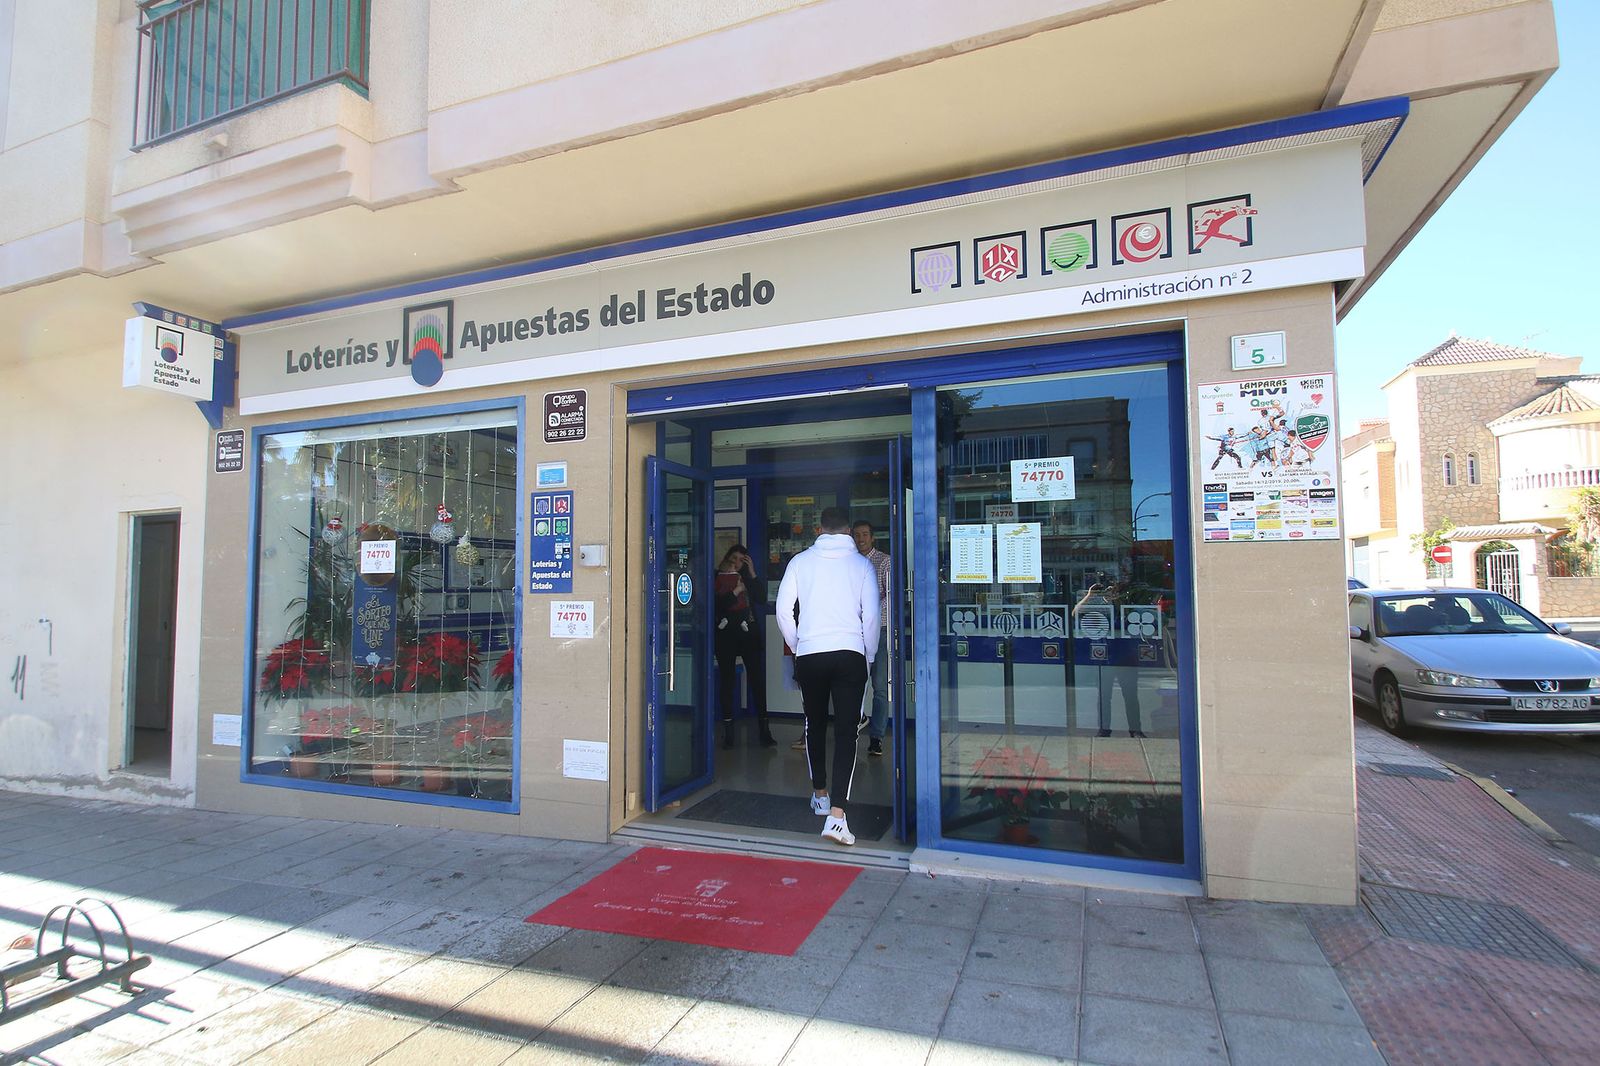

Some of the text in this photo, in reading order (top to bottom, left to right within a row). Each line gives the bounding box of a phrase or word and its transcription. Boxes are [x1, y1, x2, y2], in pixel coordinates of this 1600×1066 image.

[1081, 274, 1213, 306] Administración
[1241, 268, 1253, 285] 2
[286, 272, 776, 374] Loterías y Apuestas del Estado
[1251, 348, 1265, 365] 5
[154, 360, 184, 373] Loterías
[153, 376, 179, 388] Estado
[154, 368, 201, 385] Apuestas del
[1240, 379, 1288, 390] LAMPARAS
[1240, 387, 1288, 398] MIVI
[547, 430, 559, 438] 902
[1033, 460, 1060, 469] PREMIO
[1020, 469, 1065, 483] 74770
[1261, 470, 1274, 478] VS
[990, 510, 1014, 518] 74770
[366, 550, 391, 559] 74770
[532, 560, 563, 569] Loterías y
[532, 570, 571, 580] Apuestas del
[532, 582, 553, 590] Estado
[557, 611, 587, 622] 74770
